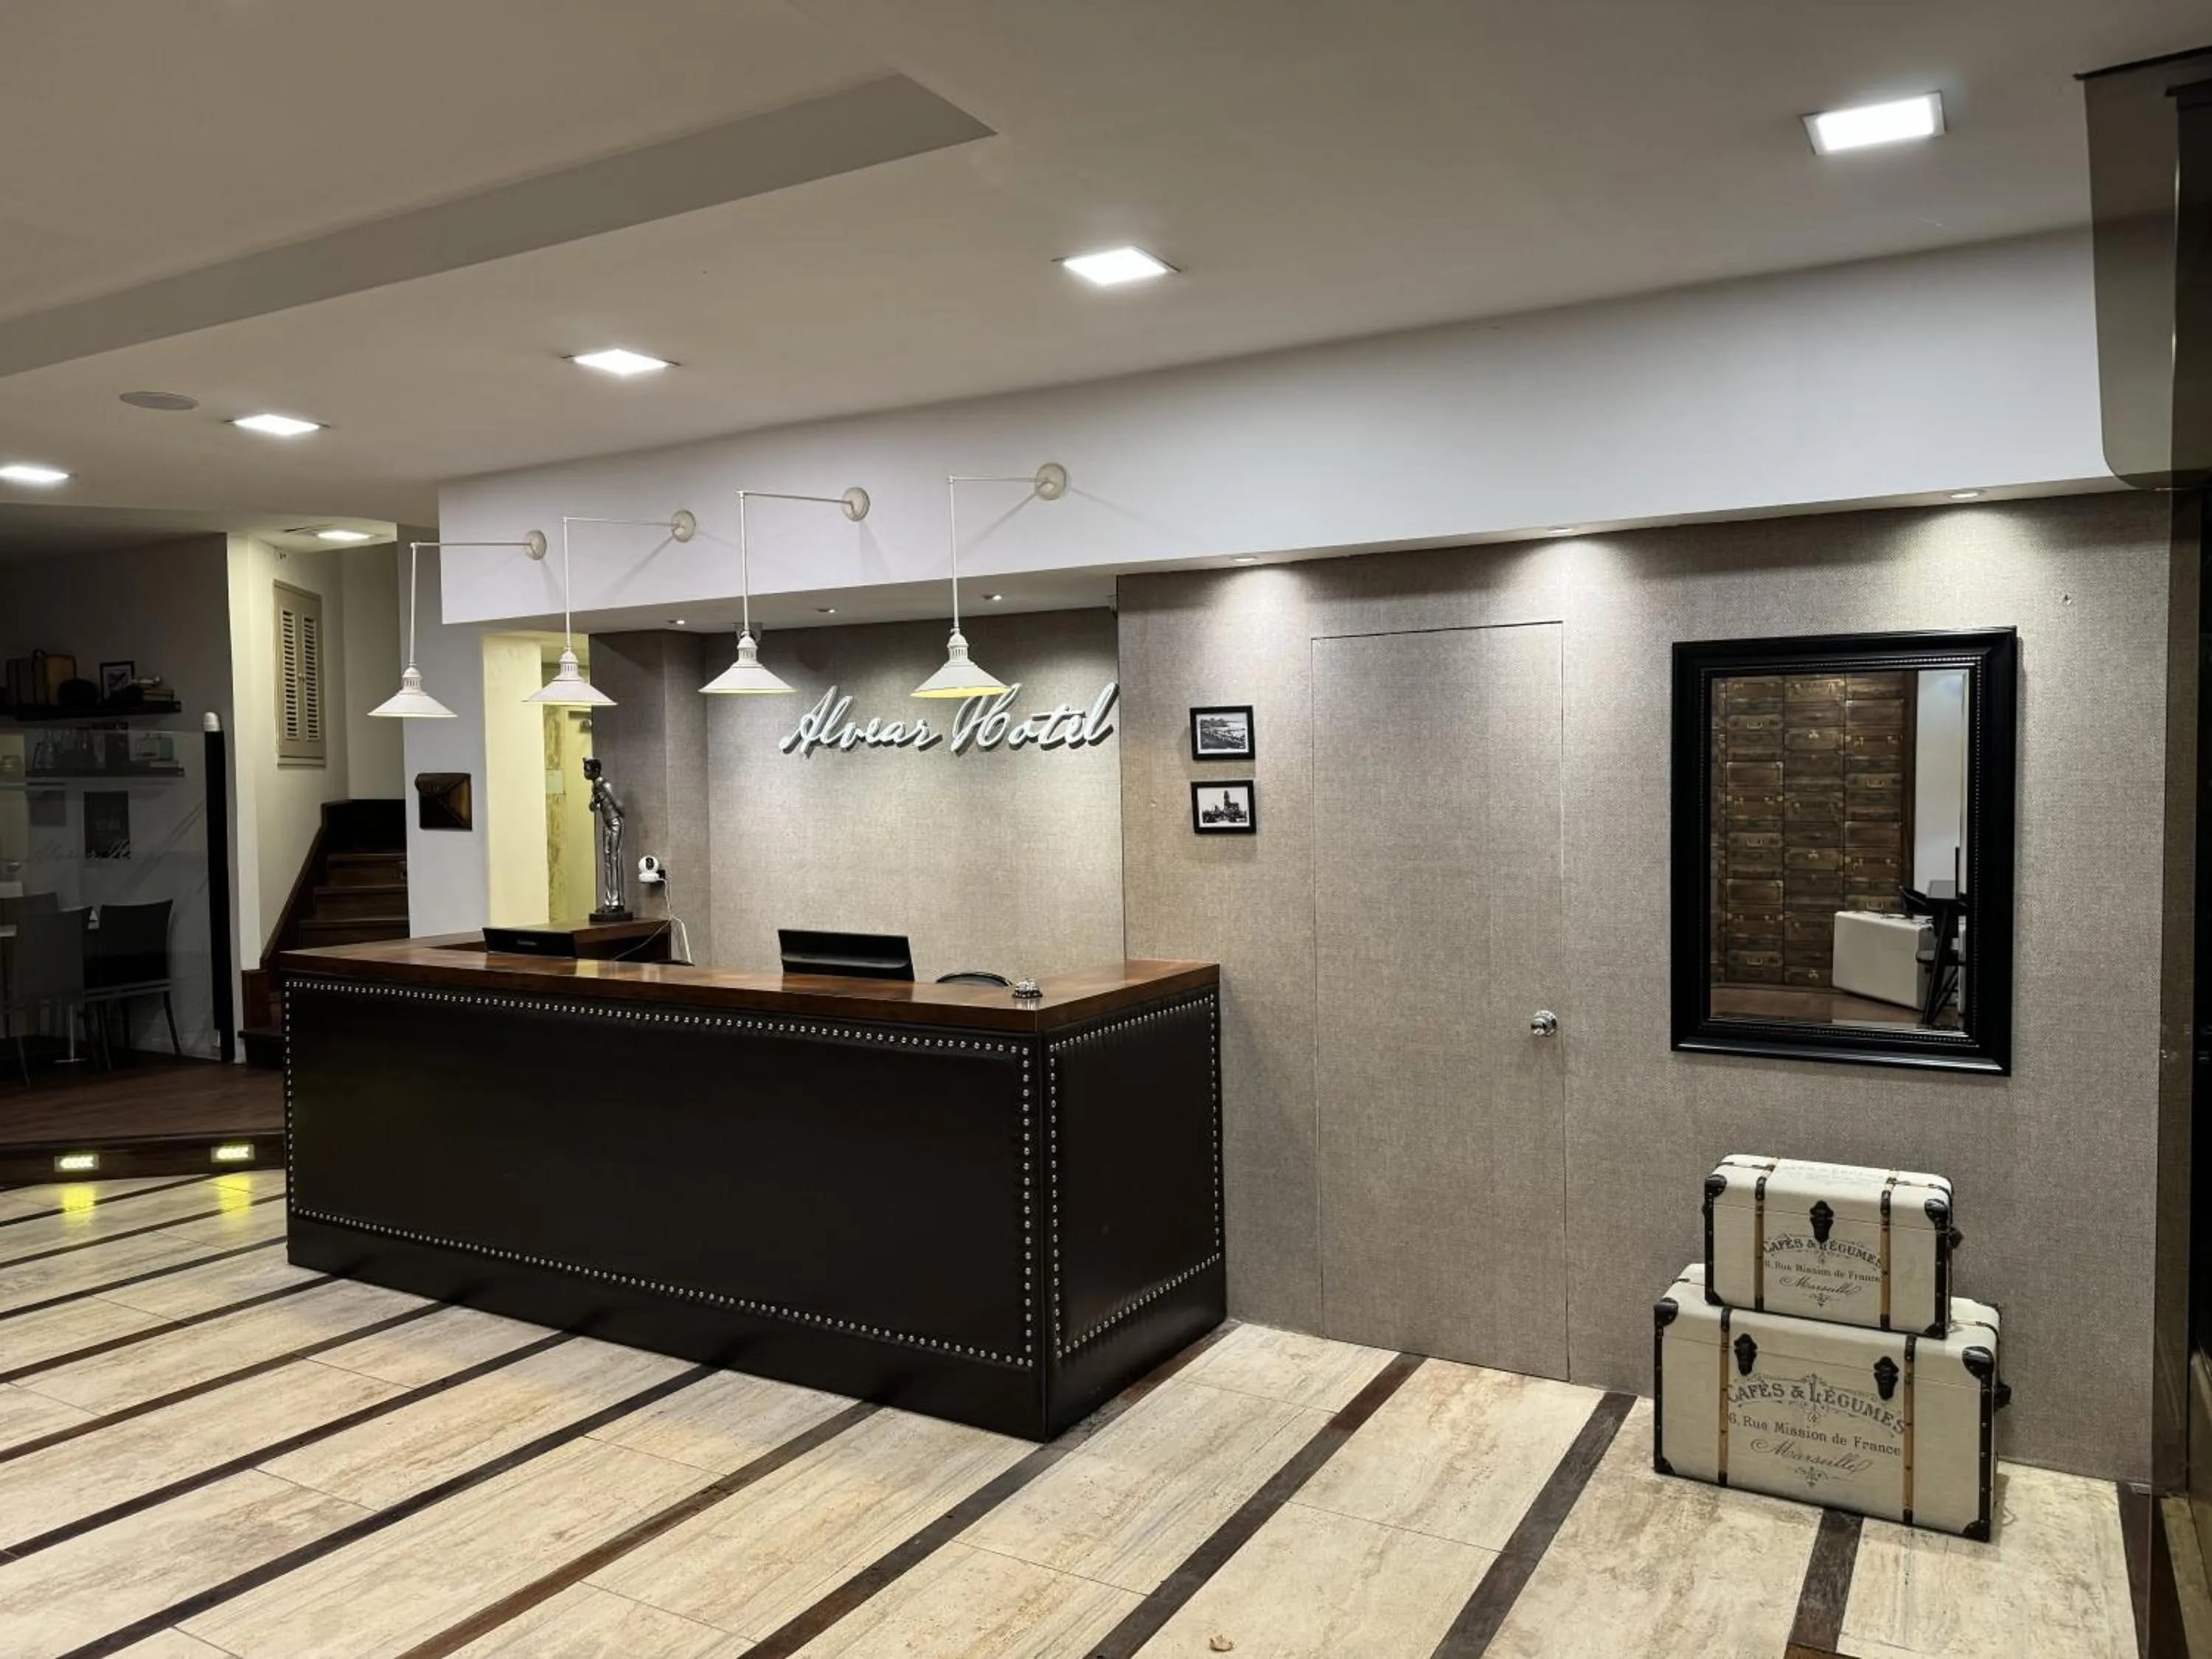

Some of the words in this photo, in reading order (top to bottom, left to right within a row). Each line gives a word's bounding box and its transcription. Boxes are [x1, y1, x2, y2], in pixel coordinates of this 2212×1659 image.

[779, 685, 942, 754] Alvear
[950, 683, 1119, 752] Hotel
[1806, 1239, 1815, 1248] &
[1790, 1385, 1804, 1400] &
[1743, 1415, 1767, 1431] Rue
[1774, 1421, 1827, 1446] Mission
[1832, 1436, 1848, 1450] de
[1854, 1439, 1901, 1460] France
